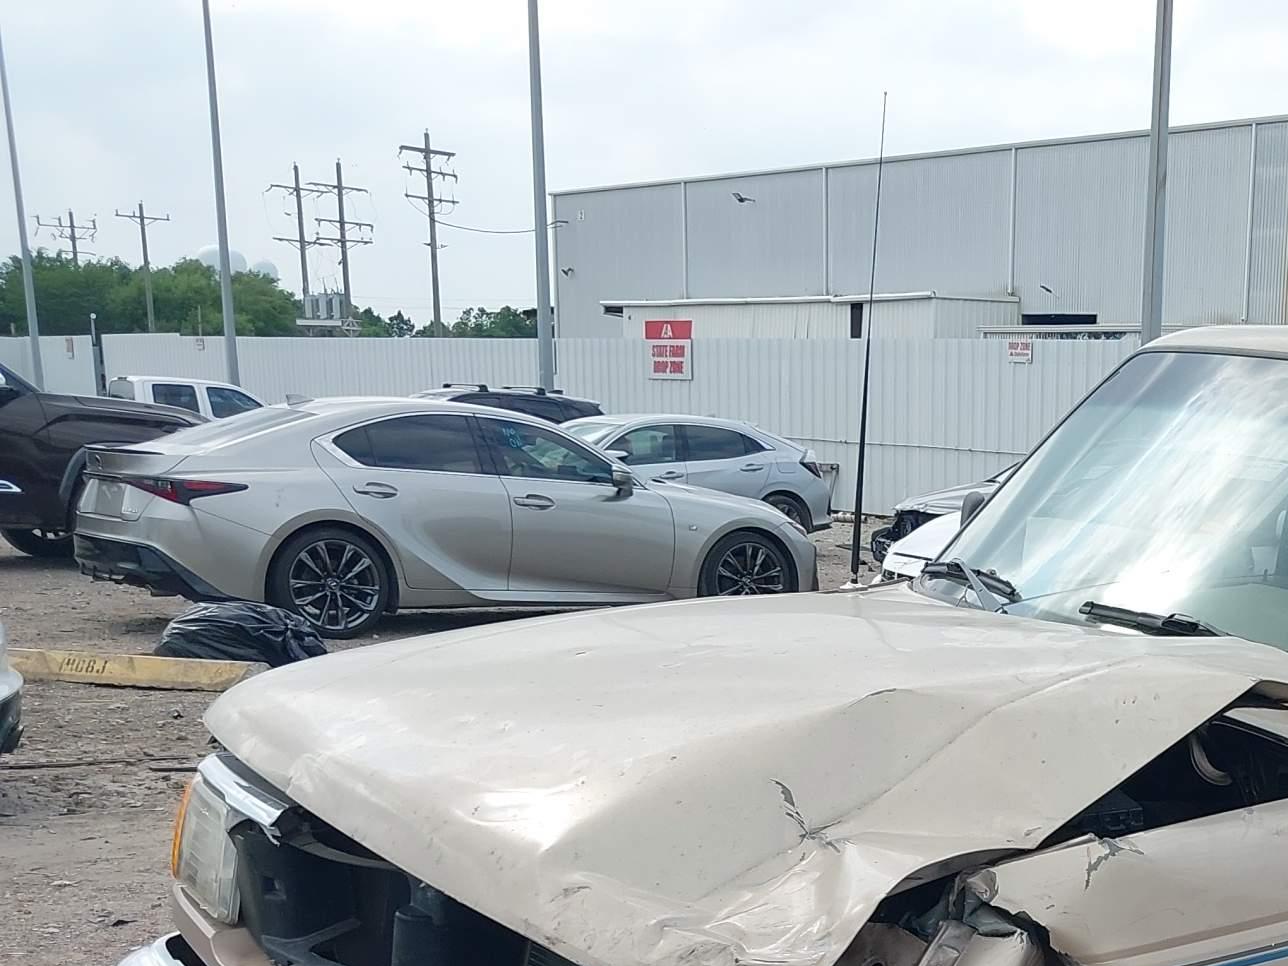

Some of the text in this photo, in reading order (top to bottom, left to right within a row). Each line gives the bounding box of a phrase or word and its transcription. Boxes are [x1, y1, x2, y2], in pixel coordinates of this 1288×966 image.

[652, 345, 685, 358] STATE FARM
[653, 361, 684, 374] DROP ZONE
